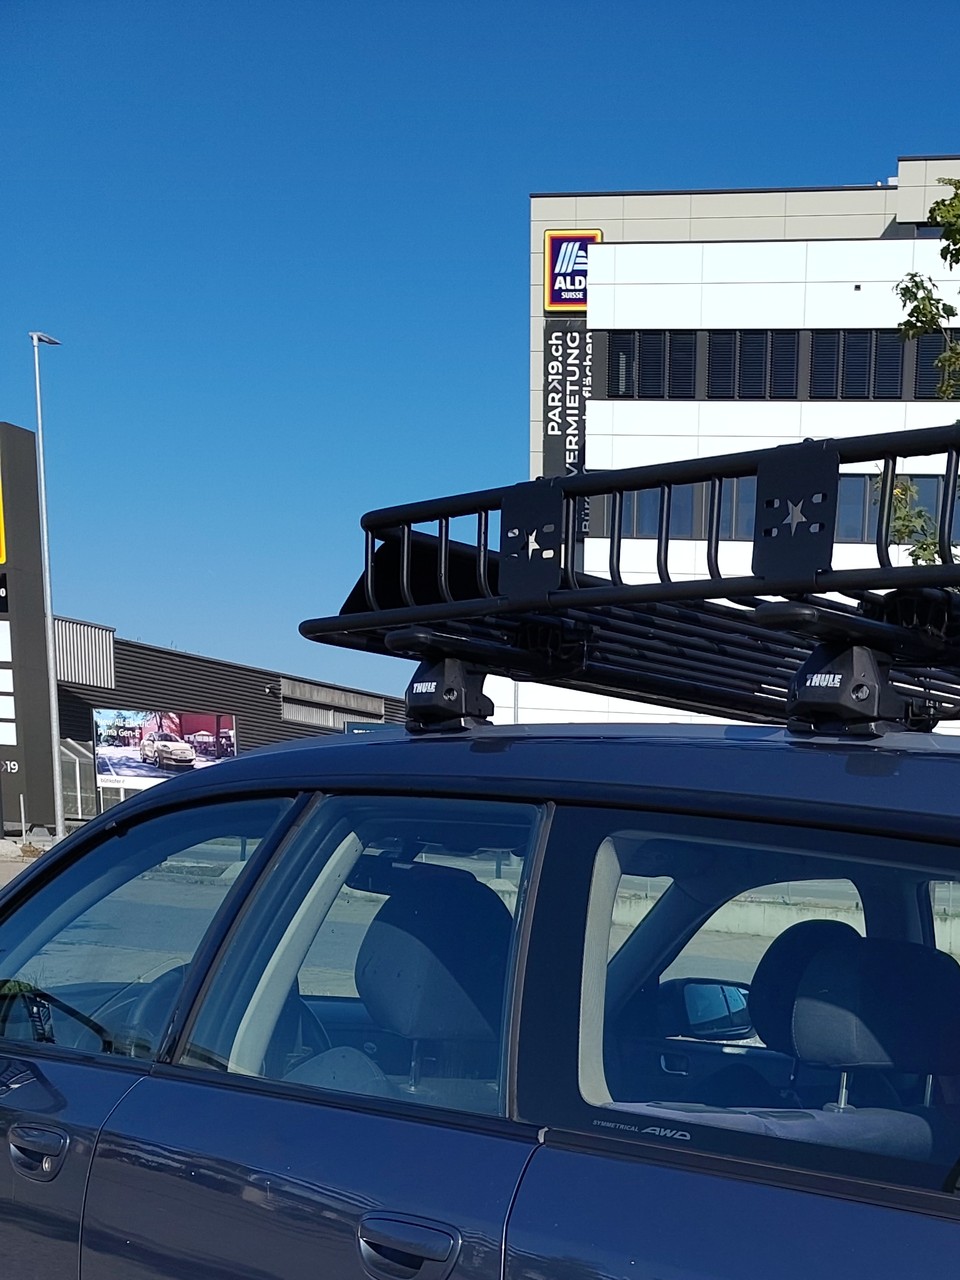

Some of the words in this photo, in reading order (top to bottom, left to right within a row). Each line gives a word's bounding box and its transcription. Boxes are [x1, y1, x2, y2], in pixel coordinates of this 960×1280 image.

[554, 275, 587, 290] ALD
[561, 291, 584, 299] SUISSE
[565, 332, 580, 477] VERMIETUNG
[805, 673, 842, 687] THULE
[412, 682, 437, 693] THULE
[97, 728, 117, 737] Puma
[592, 1119, 639, 1133] SYMMETRICAL
[641, 1126, 691, 1140] AWD
